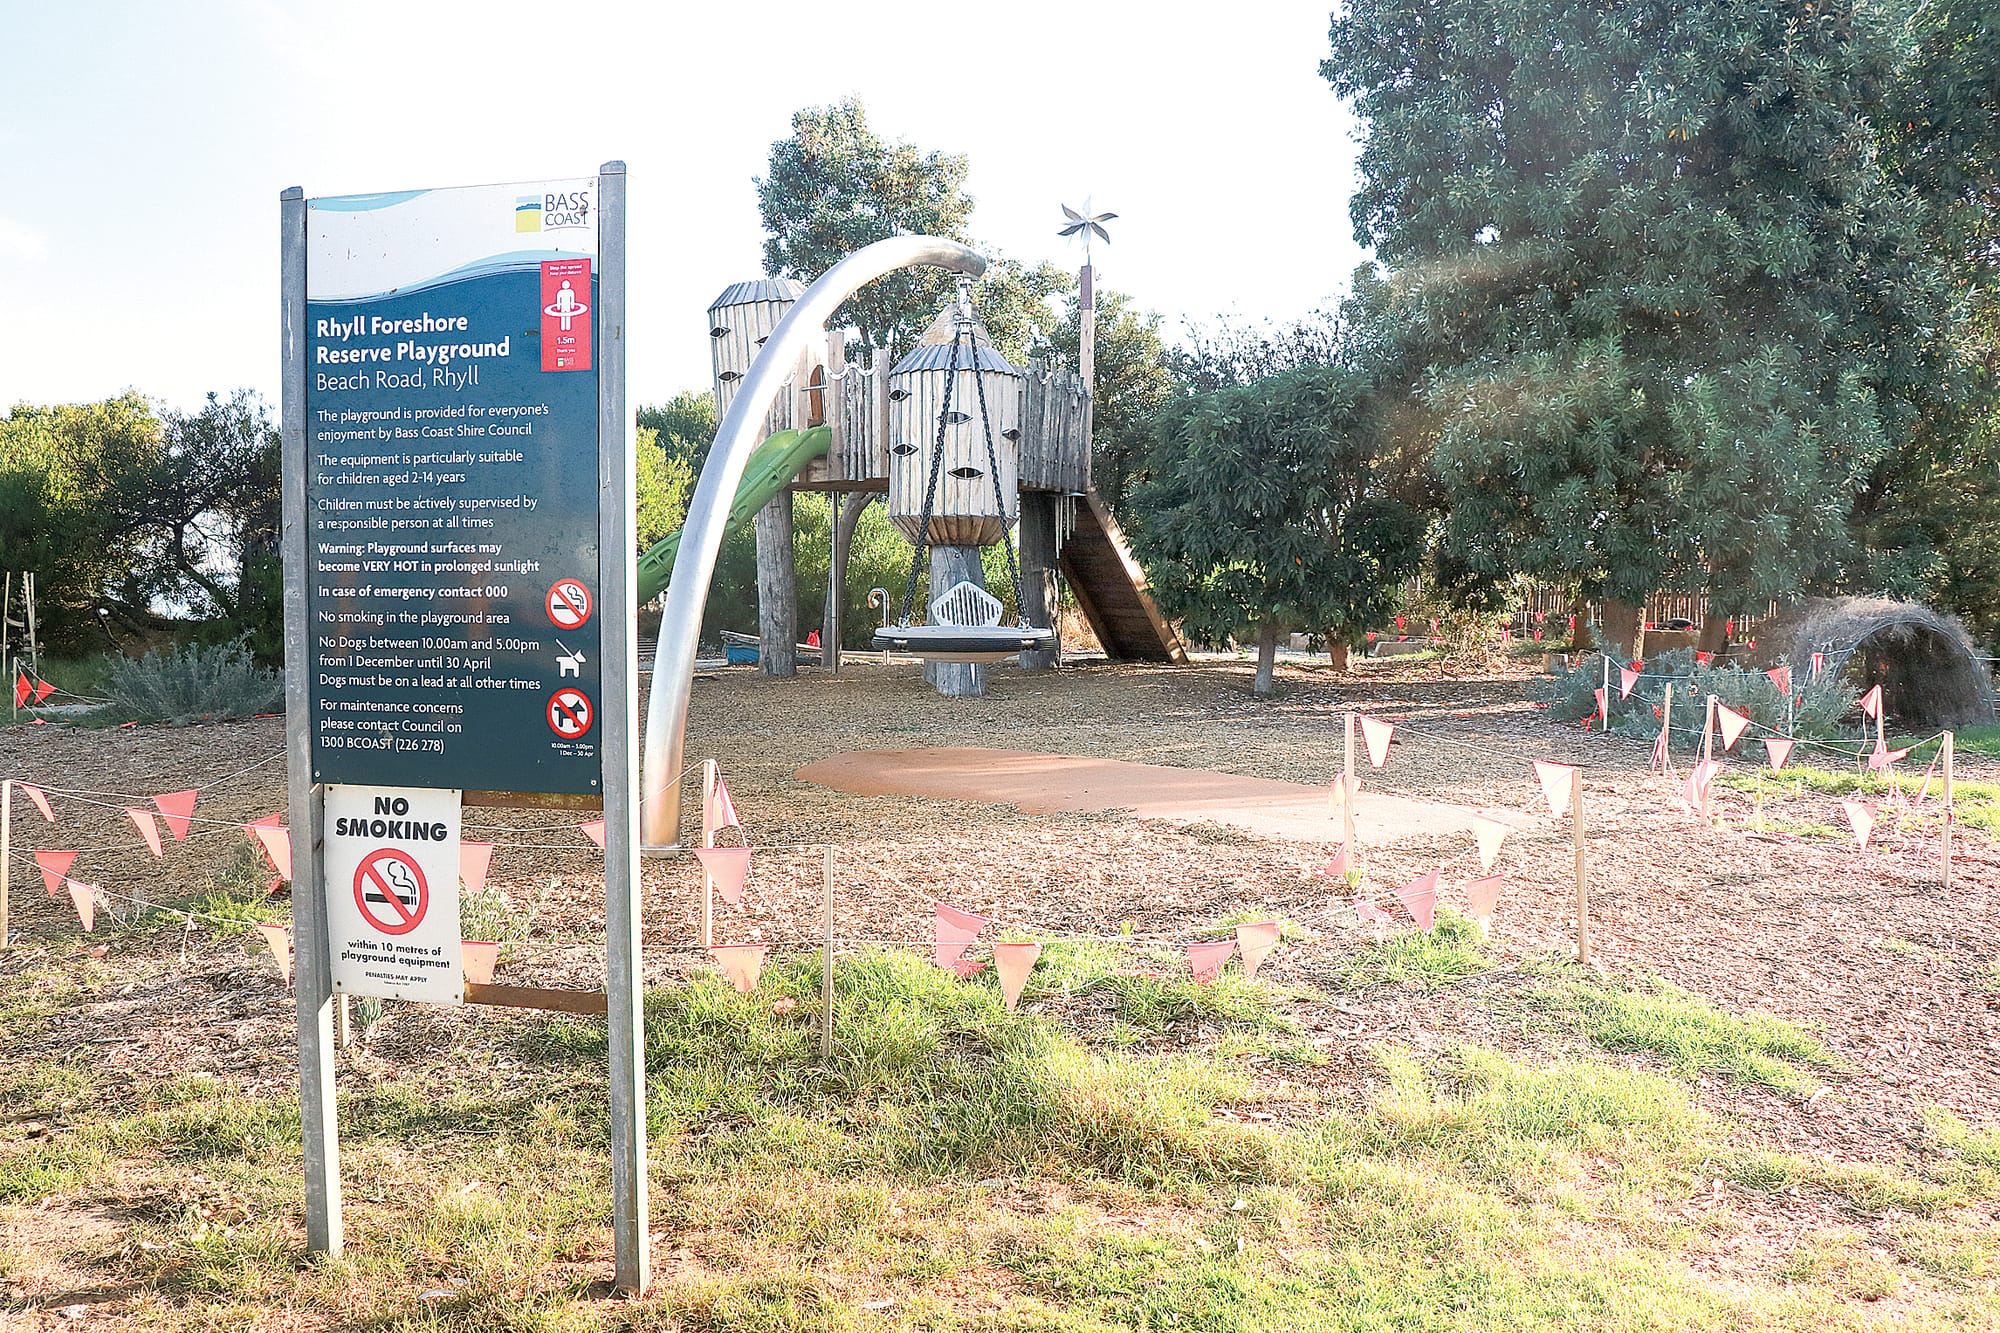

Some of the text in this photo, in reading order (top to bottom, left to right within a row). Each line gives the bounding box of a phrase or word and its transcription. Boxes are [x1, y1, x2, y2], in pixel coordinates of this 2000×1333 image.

[546, 192, 589, 212] BASS
[545, 212, 588, 226] COAST
[317, 312, 468, 342] Rhyll Foreshore
[317, 336, 510, 365] Reserve Playground
[317, 365, 479, 392] Beach Road, Rhyll
[318, 410, 338, 422] The
[341, 407, 401, 423] playground
[404, 408, 412, 419] is
[415, 405, 465, 421] provided
[468, 405, 485, 417] for
[317, 423, 532, 443] enjoyment by Bass Coast Shire Council
[318, 450, 523, 468] The equipment is particularly suitable
[318, 472, 466, 486] for children aged 2-14 years
[318, 495, 538, 512] Children must be actively supervised by
[318, 517, 494, 532] a responsible person at all times
[318, 542, 502, 557] Warning: Playground surfaces may
[318, 560, 540, 575] become VERY HOT in prolonged sunlight
[319, 585, 508, 601] In case of emergency contact 000
[319, 611, 510, 627] No smoking in the playground area
[319, 637, 540, 653] No Dogs between 10.00am and 5.00pm
[319, 655, 491, 672] from 1 December until 30 April
[320, 674, 541, 690] Dogs must be on a lead at all other times
[320, 700, 463, 714] For maintenance concerns
[320, 719, 462, 733] please contact Council on
[321, 737, 445, 755] 1300 BCOAST (226 278)
[374, 796, 409, 816] NO
[335, 817, 448, 842] SMOKING
[348, 940, 441, 956] within 10 metres of
[341, 950, 450, 968] playground equipment
[365, 971, 394, 980] PENALTIES
